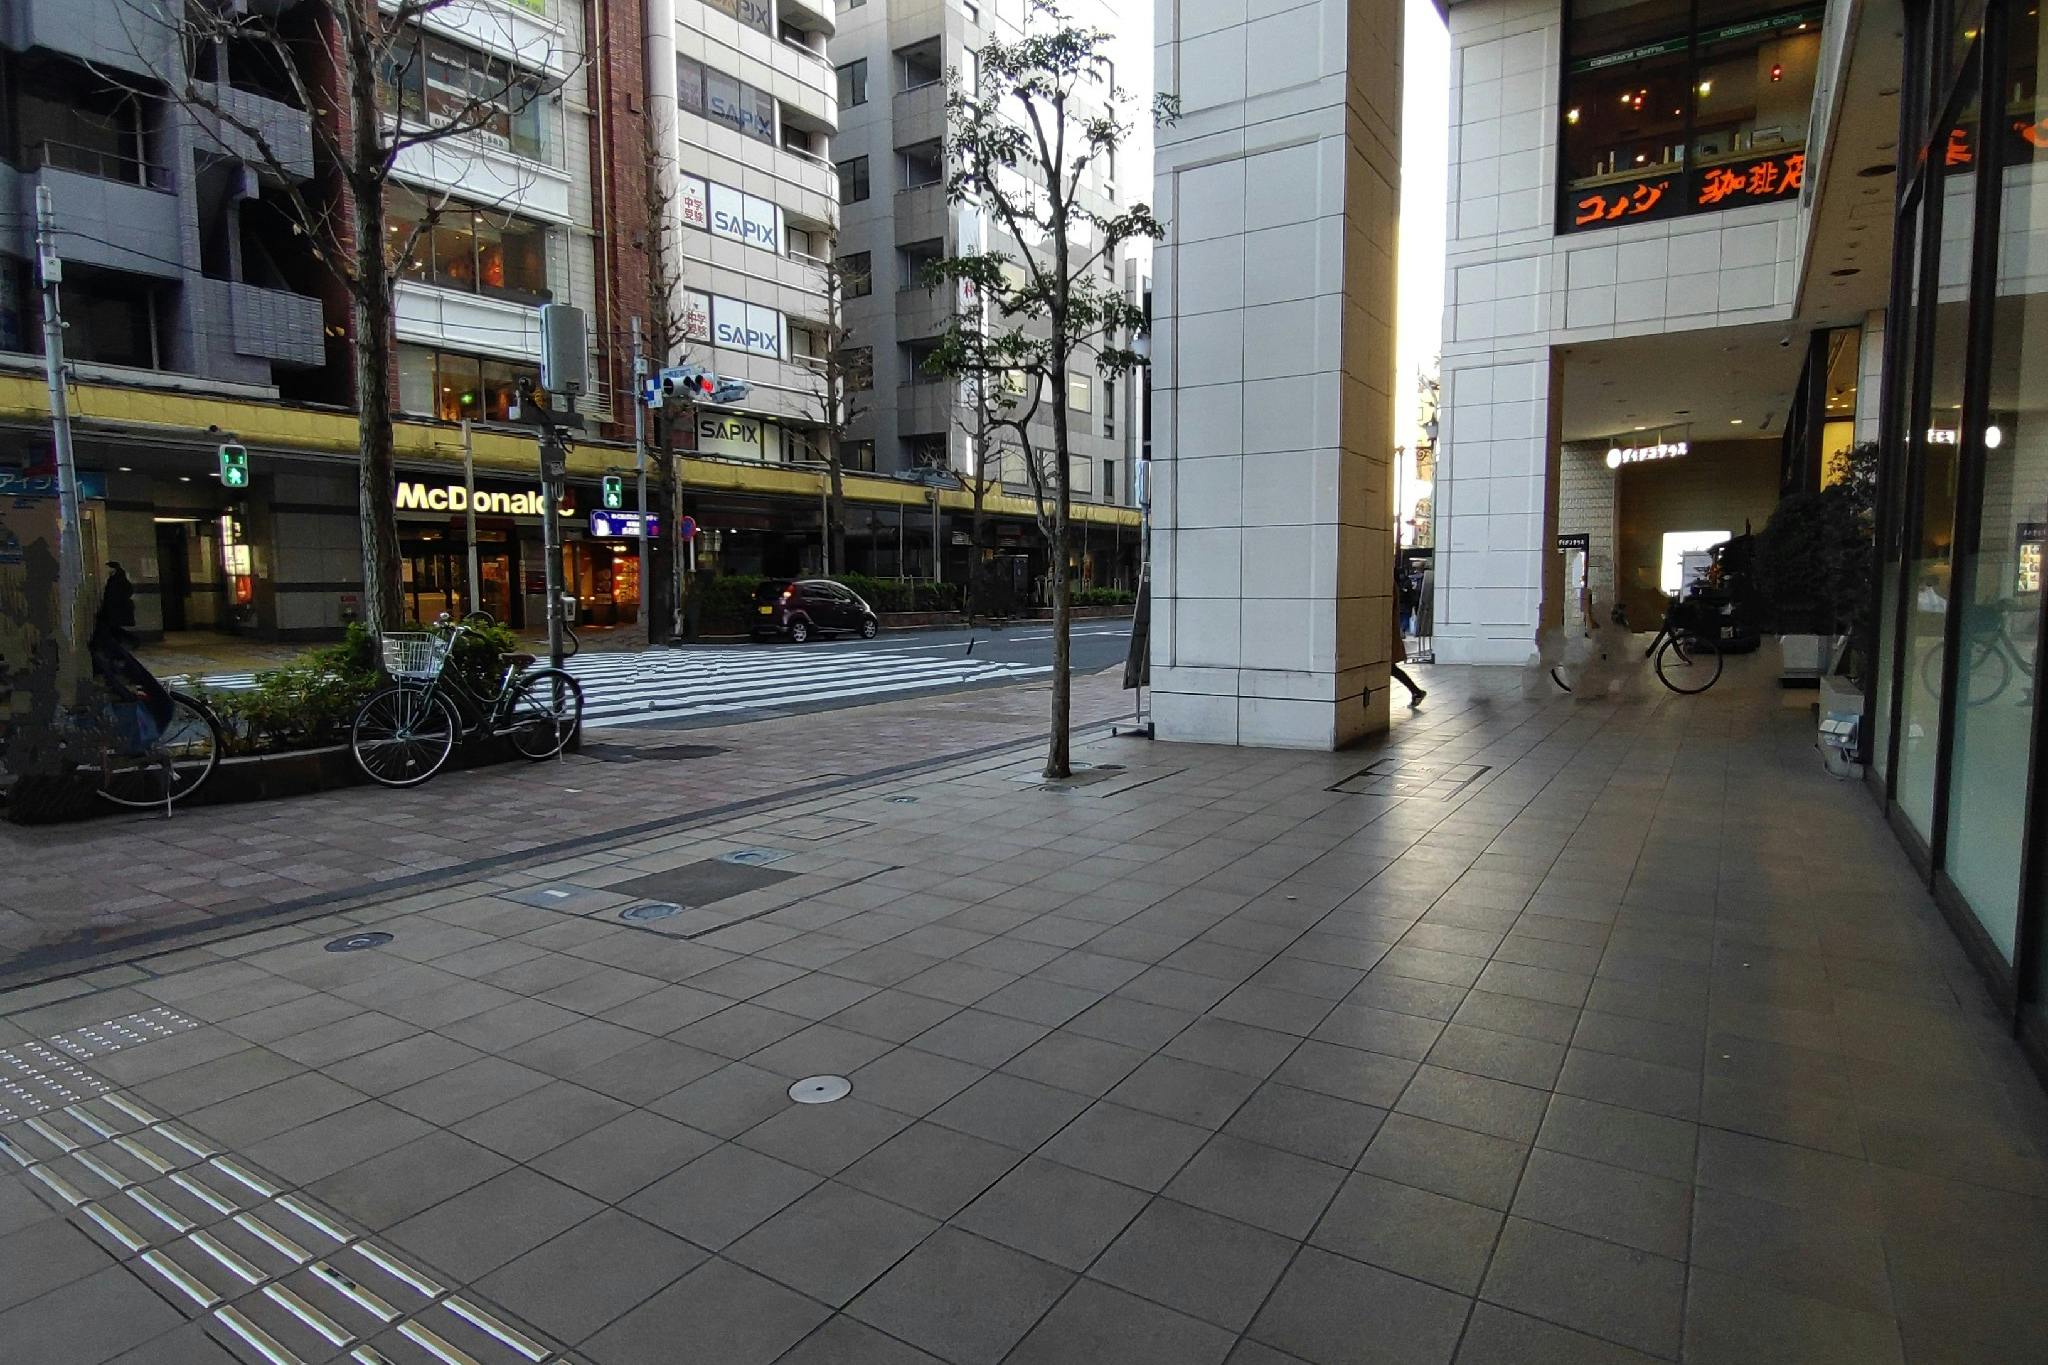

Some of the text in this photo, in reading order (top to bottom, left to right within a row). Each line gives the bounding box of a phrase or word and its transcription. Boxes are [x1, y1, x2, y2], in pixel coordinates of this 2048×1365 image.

[711, 96, 771, 137] SAPIX
[714, 210, 775, 246] SAPIX
[717, 323, 779, 352] SAPIX
[700, 421, 758, 444] SAPIX
[396, 481, 575, 517] McDonal
